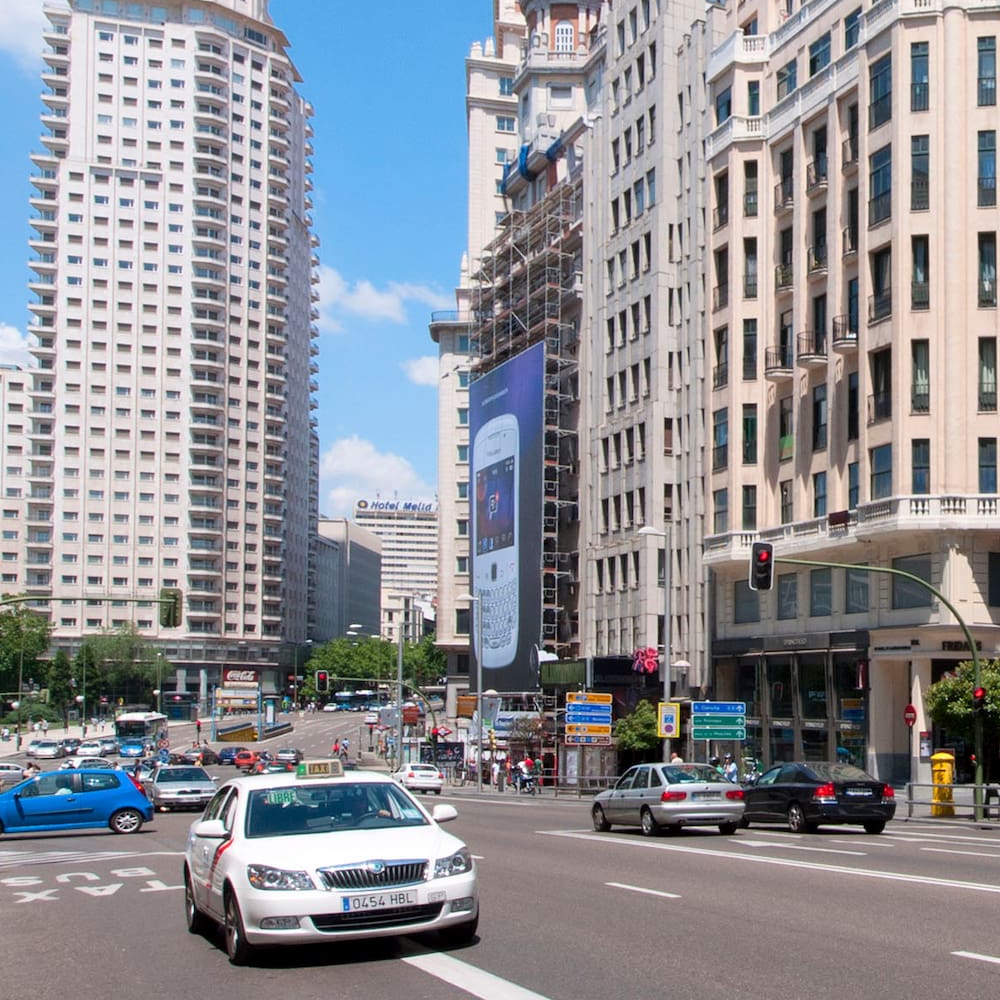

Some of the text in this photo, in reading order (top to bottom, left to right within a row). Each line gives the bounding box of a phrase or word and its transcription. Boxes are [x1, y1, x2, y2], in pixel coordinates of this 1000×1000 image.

[371, 501, 399, 510] Hotel
[310, 763, 329, 774] TAXI
[268, 791, 295, 804] LIBRE
[352, 893, 414, 909] 0454 HBL
